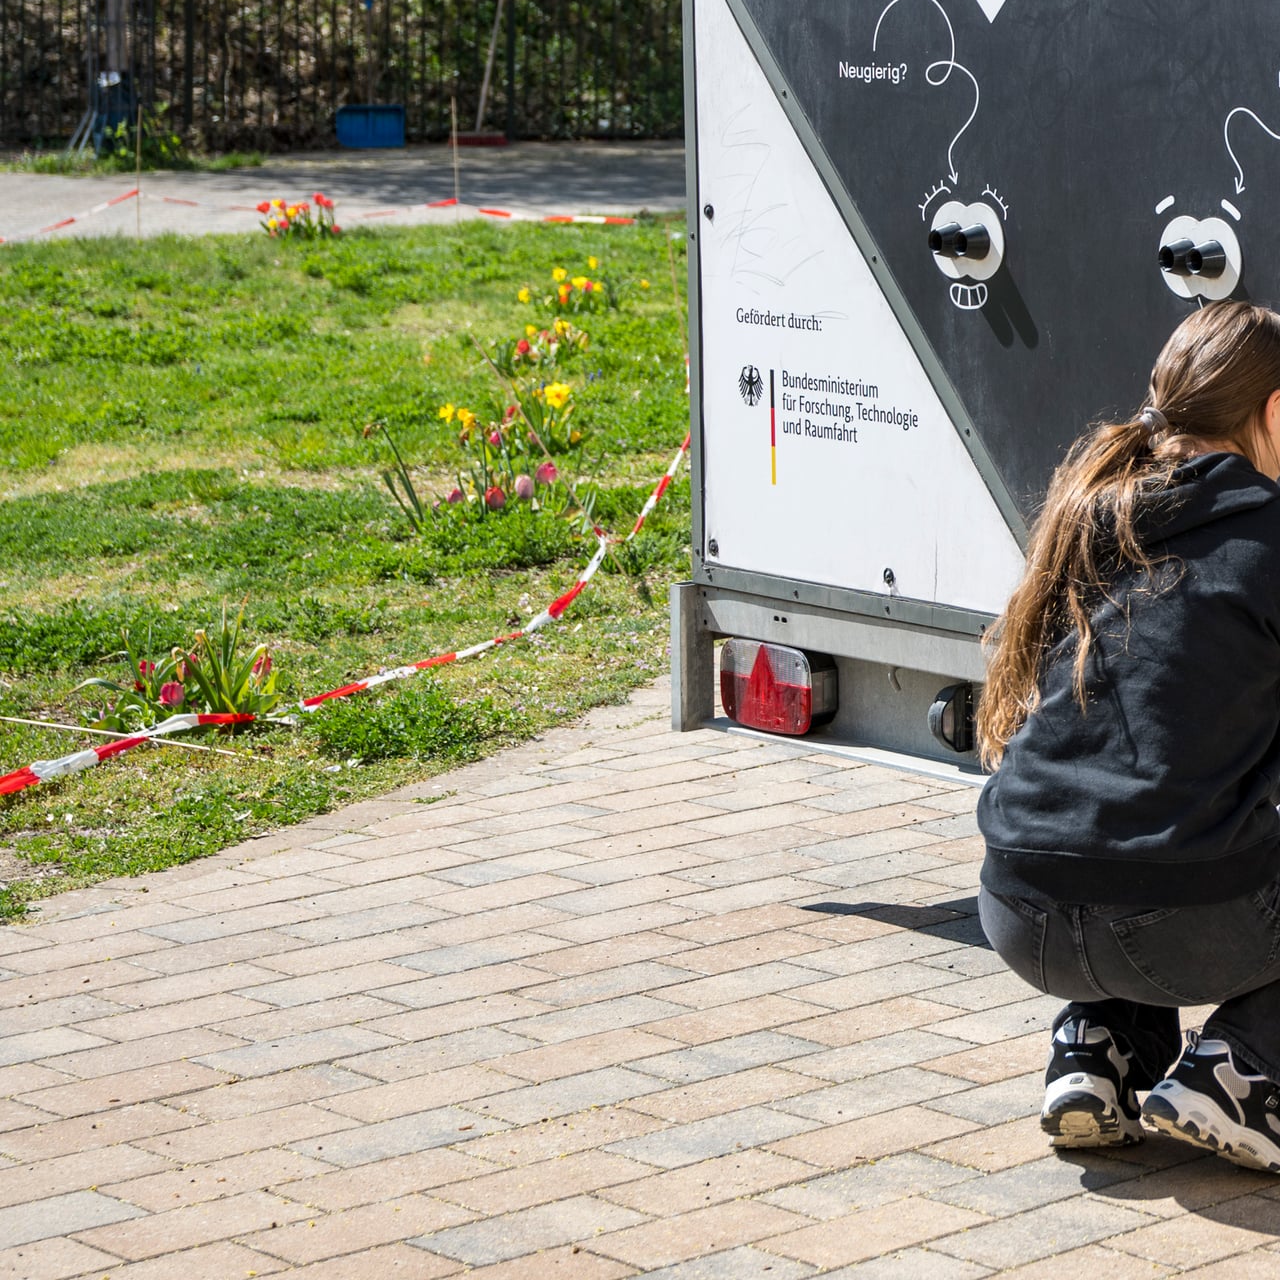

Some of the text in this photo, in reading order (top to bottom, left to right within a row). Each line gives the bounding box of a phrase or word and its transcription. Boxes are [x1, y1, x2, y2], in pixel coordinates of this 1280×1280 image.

[839, 61, 908, 85] Neugierig?
[736, 307, 822, 332] Gefördert durch:
[782, 370, 880, 399] Bundesministerium
[782, 394, 919, 432] für Forschung, Technologie
[782, 418, 858, 444] und Raumfahrt
